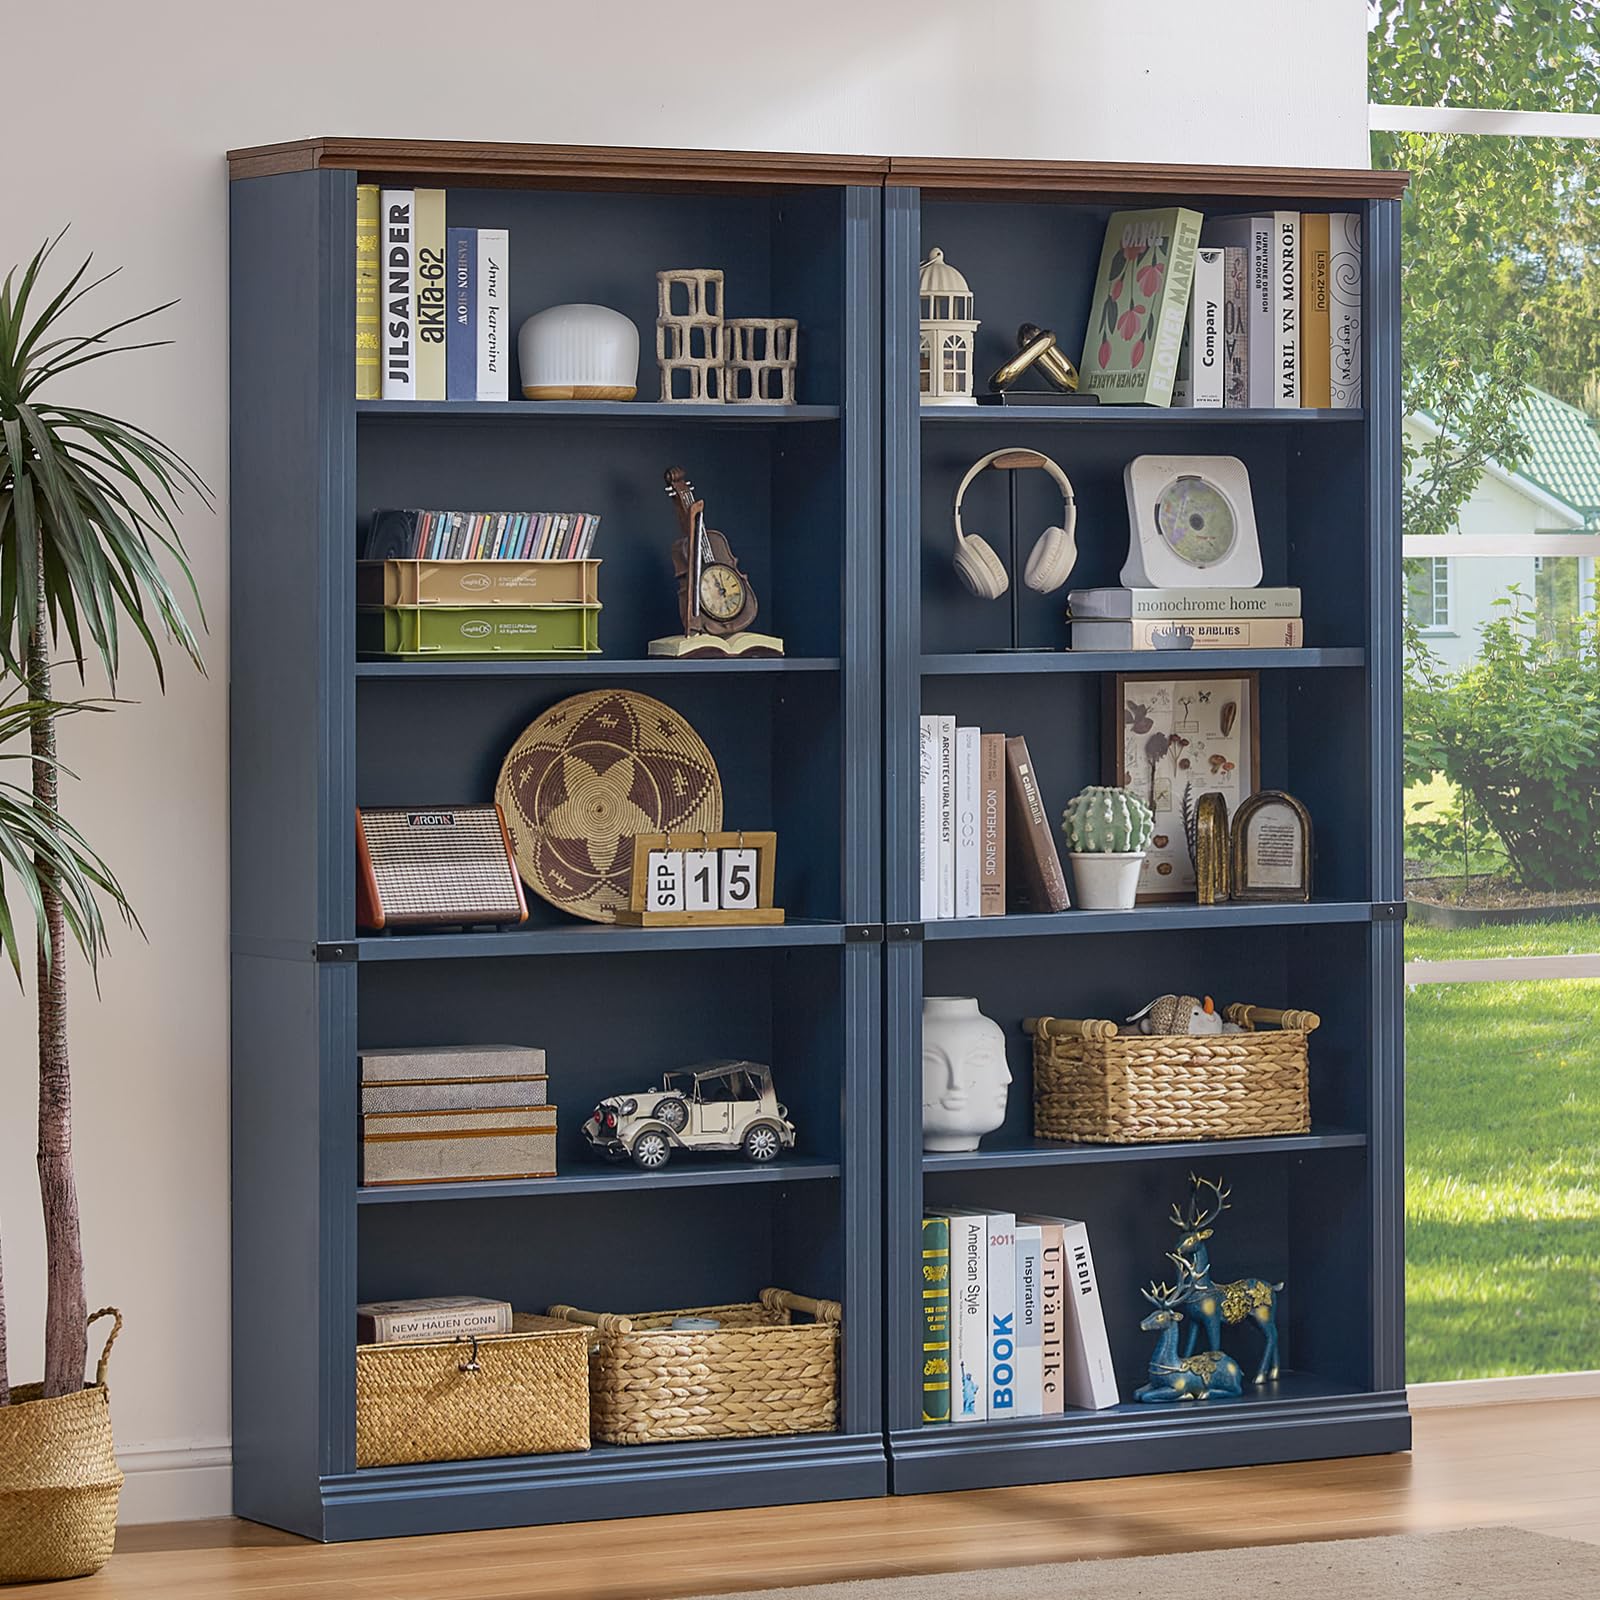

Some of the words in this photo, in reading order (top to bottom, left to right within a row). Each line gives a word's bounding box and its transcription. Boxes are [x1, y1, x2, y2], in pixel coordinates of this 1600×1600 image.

[457, 240, 468, 288] FASHION
[488, 257, 500, 298] Anna
[1168, 222, 1199, 306] MARKET
[1282, 223, 1295, 301] MONROE
[1317, 253, 1325, 277] LISA
[389, 203, 410, 383] JILSANDER
[457, 290, 468, 326] SHOW
[1317, 279, 1325, 309] ZHOU
[1153, 308, 1185, 391] FLOWER
[1202, 300, 1218, 367] Company
[1342, 314, 1351, 380] Madame
[1088, 374, 1117, 389] MARKET
[1117, 373, 1145, 388] FLOWER
[1137, 597, 1226, 612] monochrome
[1229, 596, 1267, 611] home
[942, 736, 950, 810] ARCHITECTURAL
[413, 815, 452, 825] AROMA
[942, 811, 950, 843] DIGEST
[961, 812, 974, 847] COS
[986, 789, 998, 839] SHELDON
[985, 840, 996, 876] SIDNEY
[657, 864, 676, 906] SEP
[967, 1223, 981, 1281] American
[990, 1235, 1015, 1246] 2011
[1023, 1256, 1035, 1326] Inspiration
[1073, 1246, 1092, 1296] INEDIA
[965, 1284, 981, 1315] Style
[1043, 1246, 1061, 1393] Urbänlike
[392, 1324, 418, 1333] NEW
[464, 1316, 496, 1326] CONN
[992, 1312, 1014, 1409] BOOK
